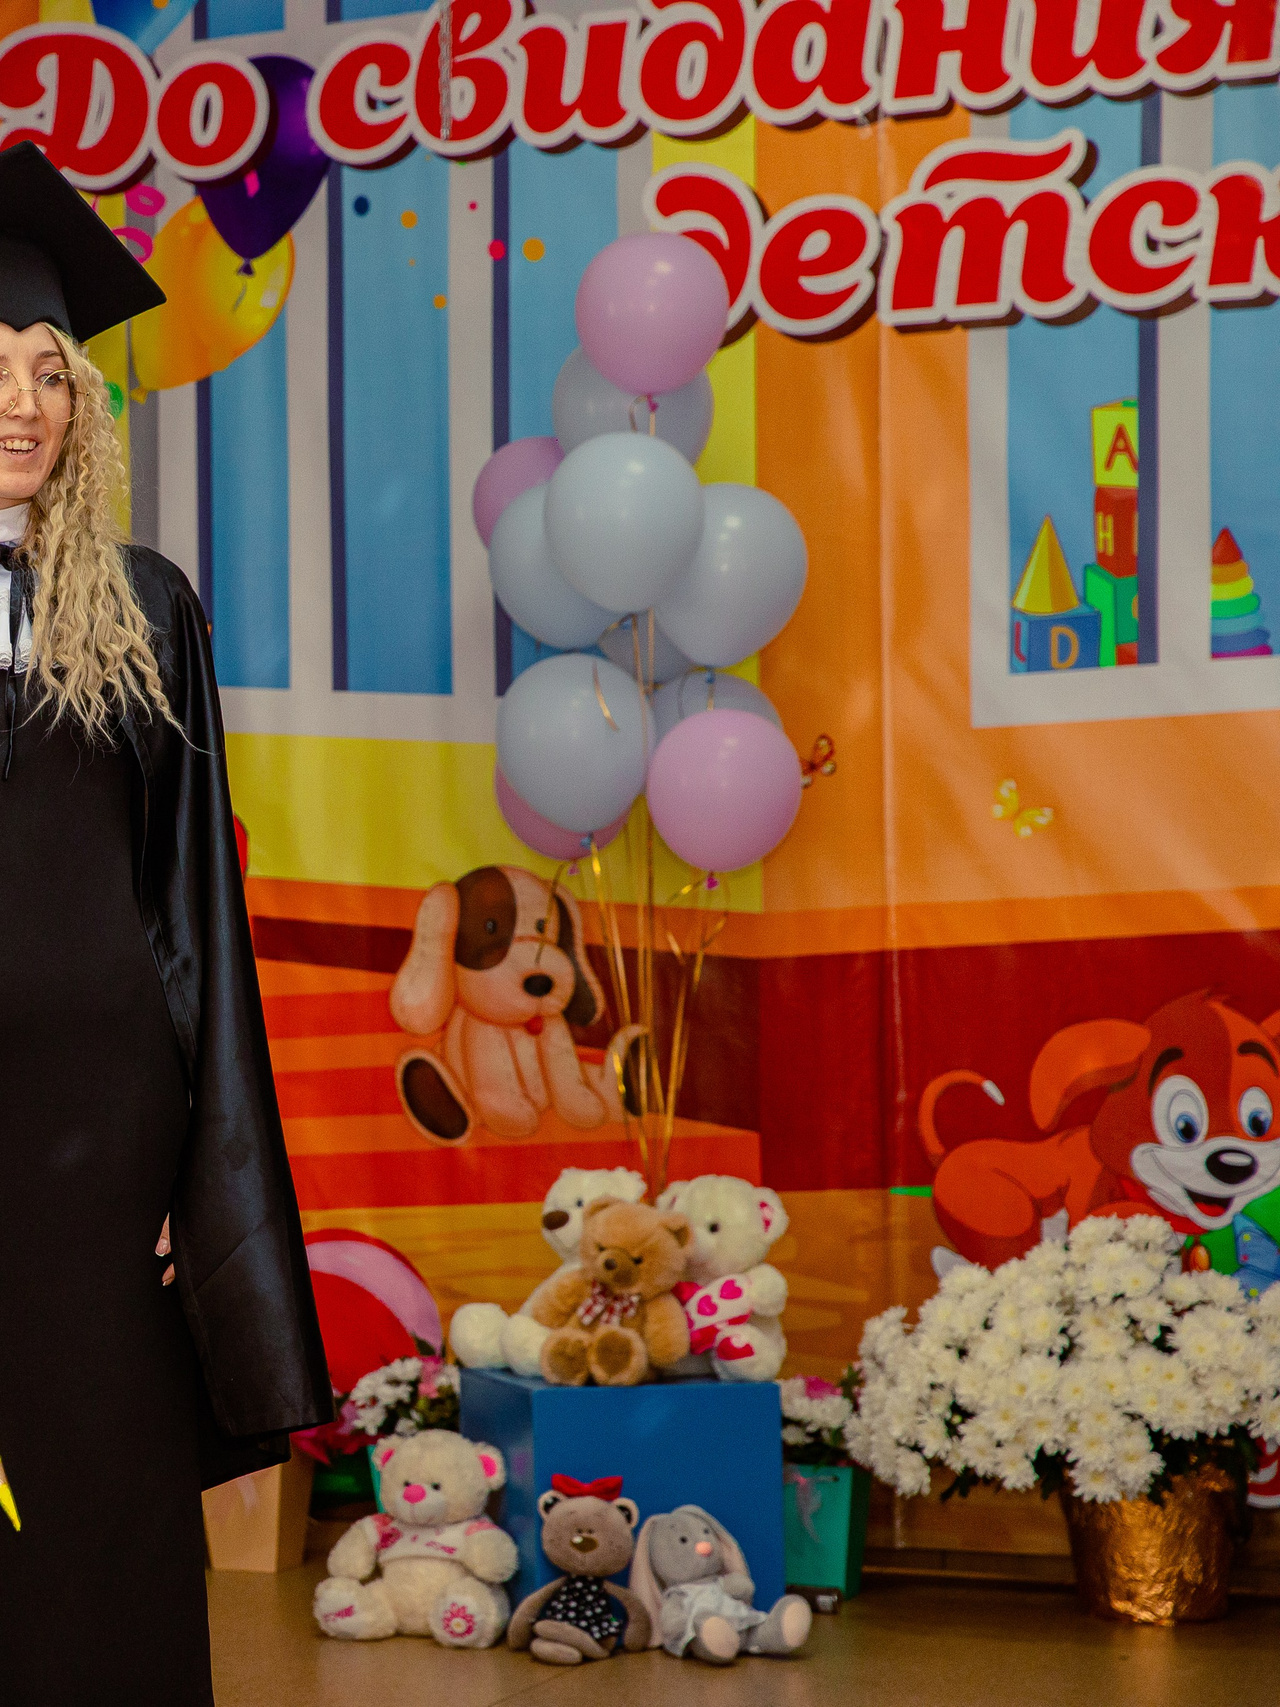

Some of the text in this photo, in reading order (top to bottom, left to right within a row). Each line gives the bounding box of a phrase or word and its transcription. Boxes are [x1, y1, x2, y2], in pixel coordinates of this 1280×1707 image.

[312, 0, 1280, 158] свидания
[1104, 423, 1138, 473] A
[1050, 625, 1079, 669] D
